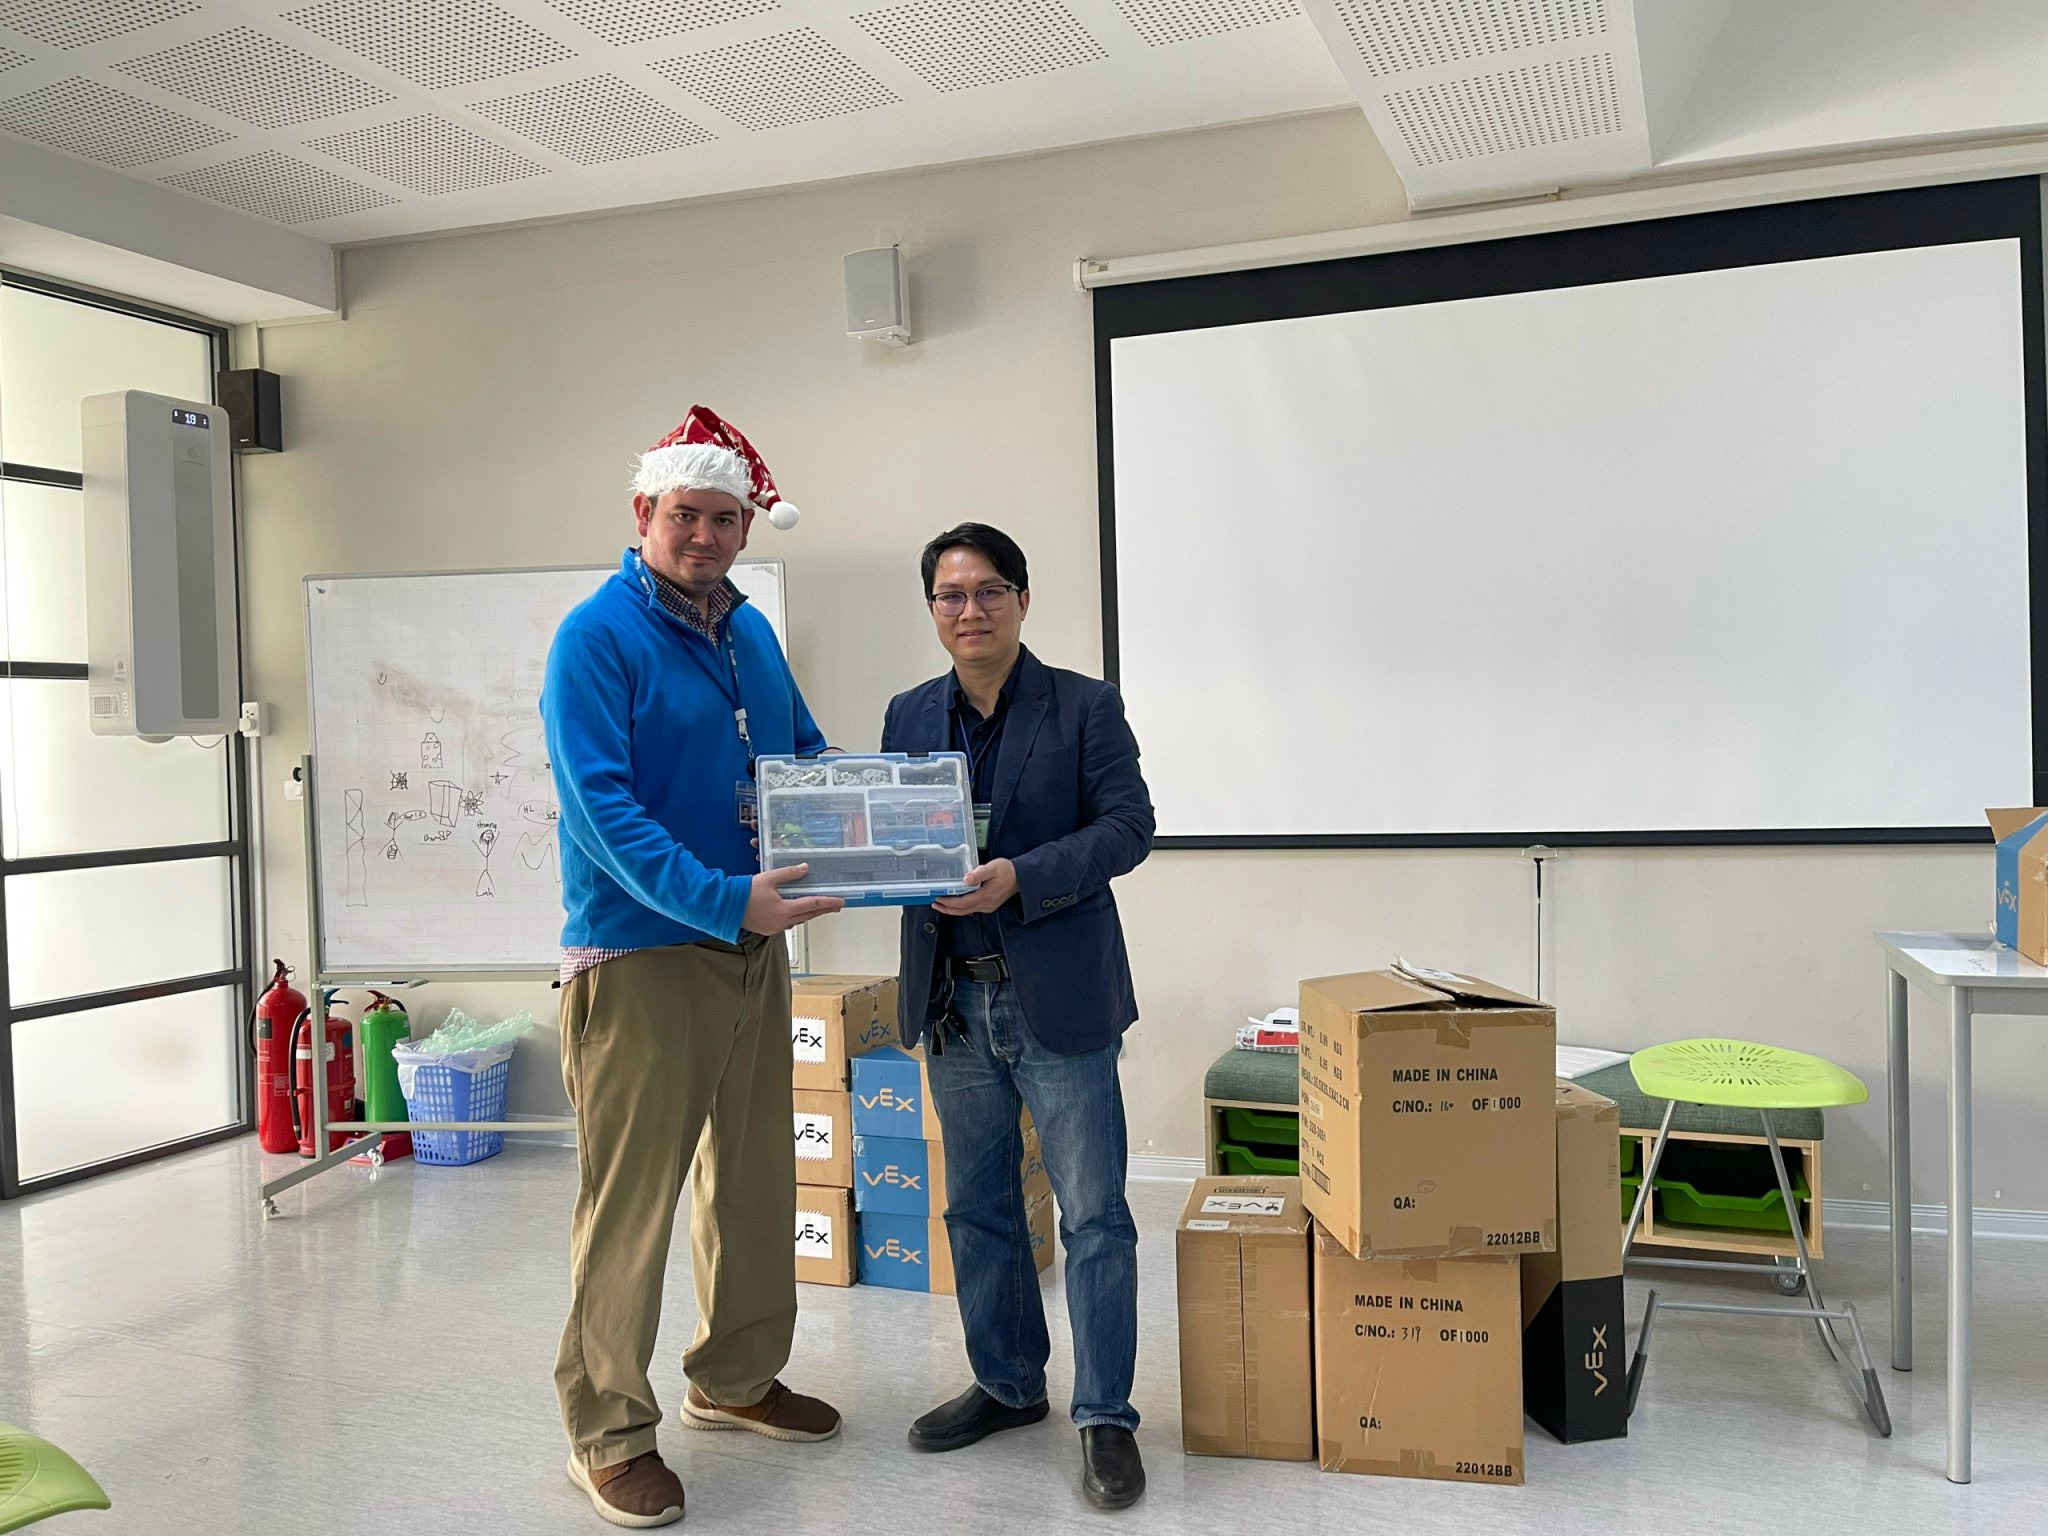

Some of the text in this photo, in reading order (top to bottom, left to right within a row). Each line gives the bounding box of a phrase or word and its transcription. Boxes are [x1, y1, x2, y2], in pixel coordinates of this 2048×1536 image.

[859, 1019, 891, 1044] VEX
[1392, 1068, 1499, 1083] MADE IN CHINA
[858, 1088, 916, 1112] VEX
[1392, 1099, 1433, 1113] C/NO.:
[862, 1165, 922, 1190] VEX
[1393, 1198, 1416, 1210] QA:
[1486, 1232, 1541, 1247] 22012BB
[864, 1239, 924, 1265] VEX
[1355, 1295, 1464, 1312] MADE IN CHINA
[1355, 1324, 1395, 1338] C/NO.:
[1584, 1323, 1608, 1397] VEX
[1359, 1417, 1382, 1430] QA:
[1455, 1462, 1513, 1477] 22012BB
